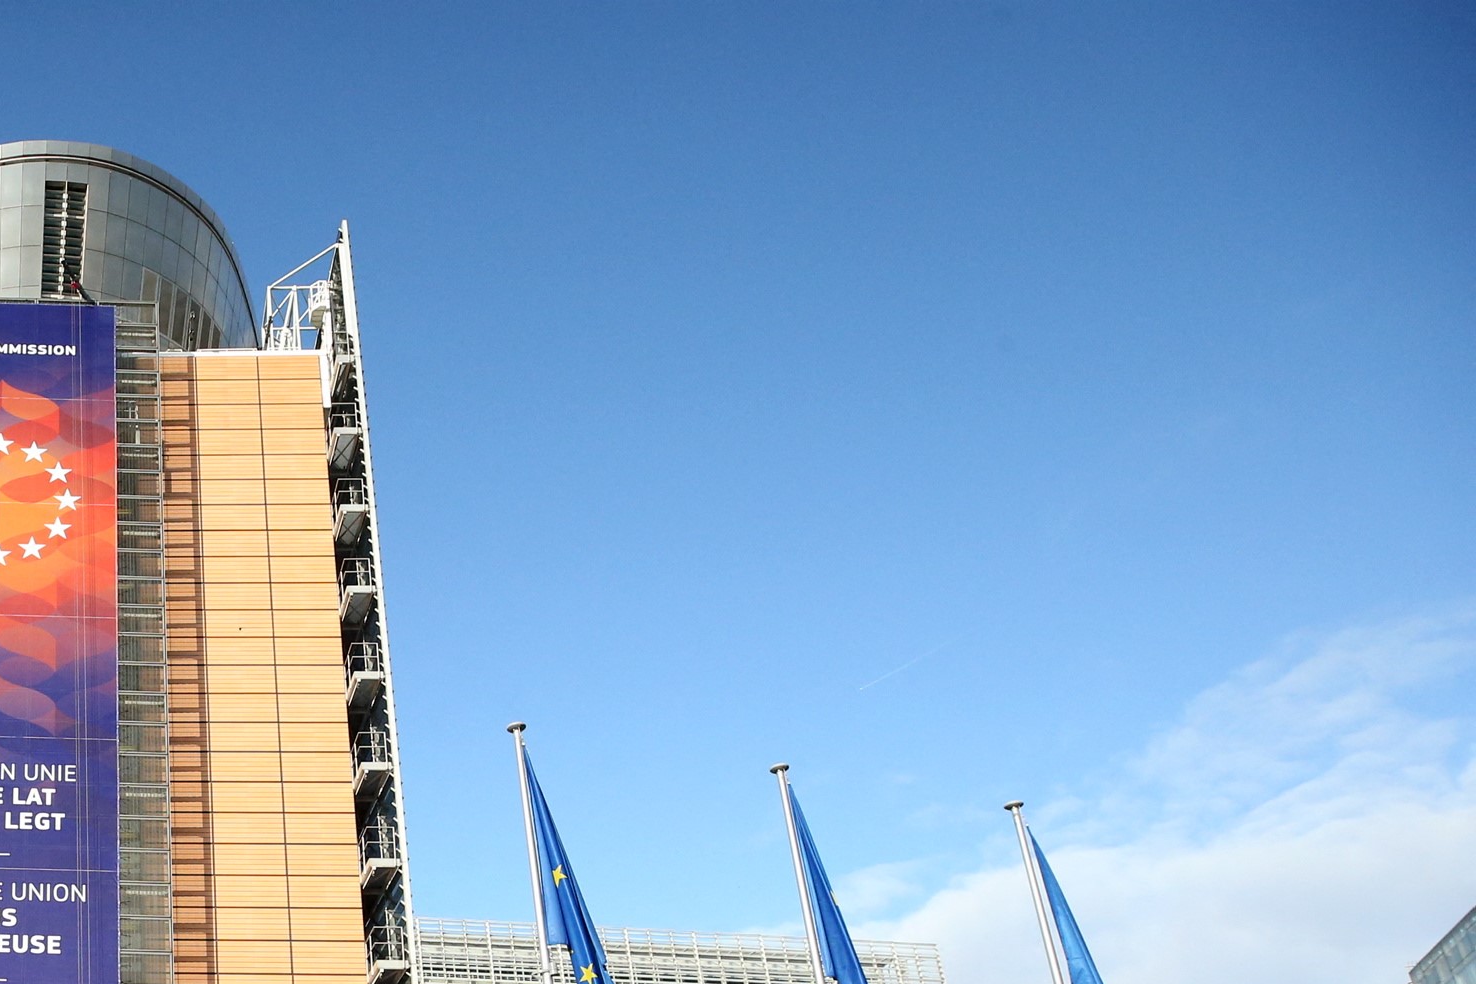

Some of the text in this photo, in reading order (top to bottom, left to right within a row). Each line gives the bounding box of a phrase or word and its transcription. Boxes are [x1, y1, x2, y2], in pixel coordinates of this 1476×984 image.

[23, 764, 77, 782] UNIE
[11, 787, 56, 806] LAT
[4, 812, 66, 831] LEGT
[11, 882, 87, 903] UNION
